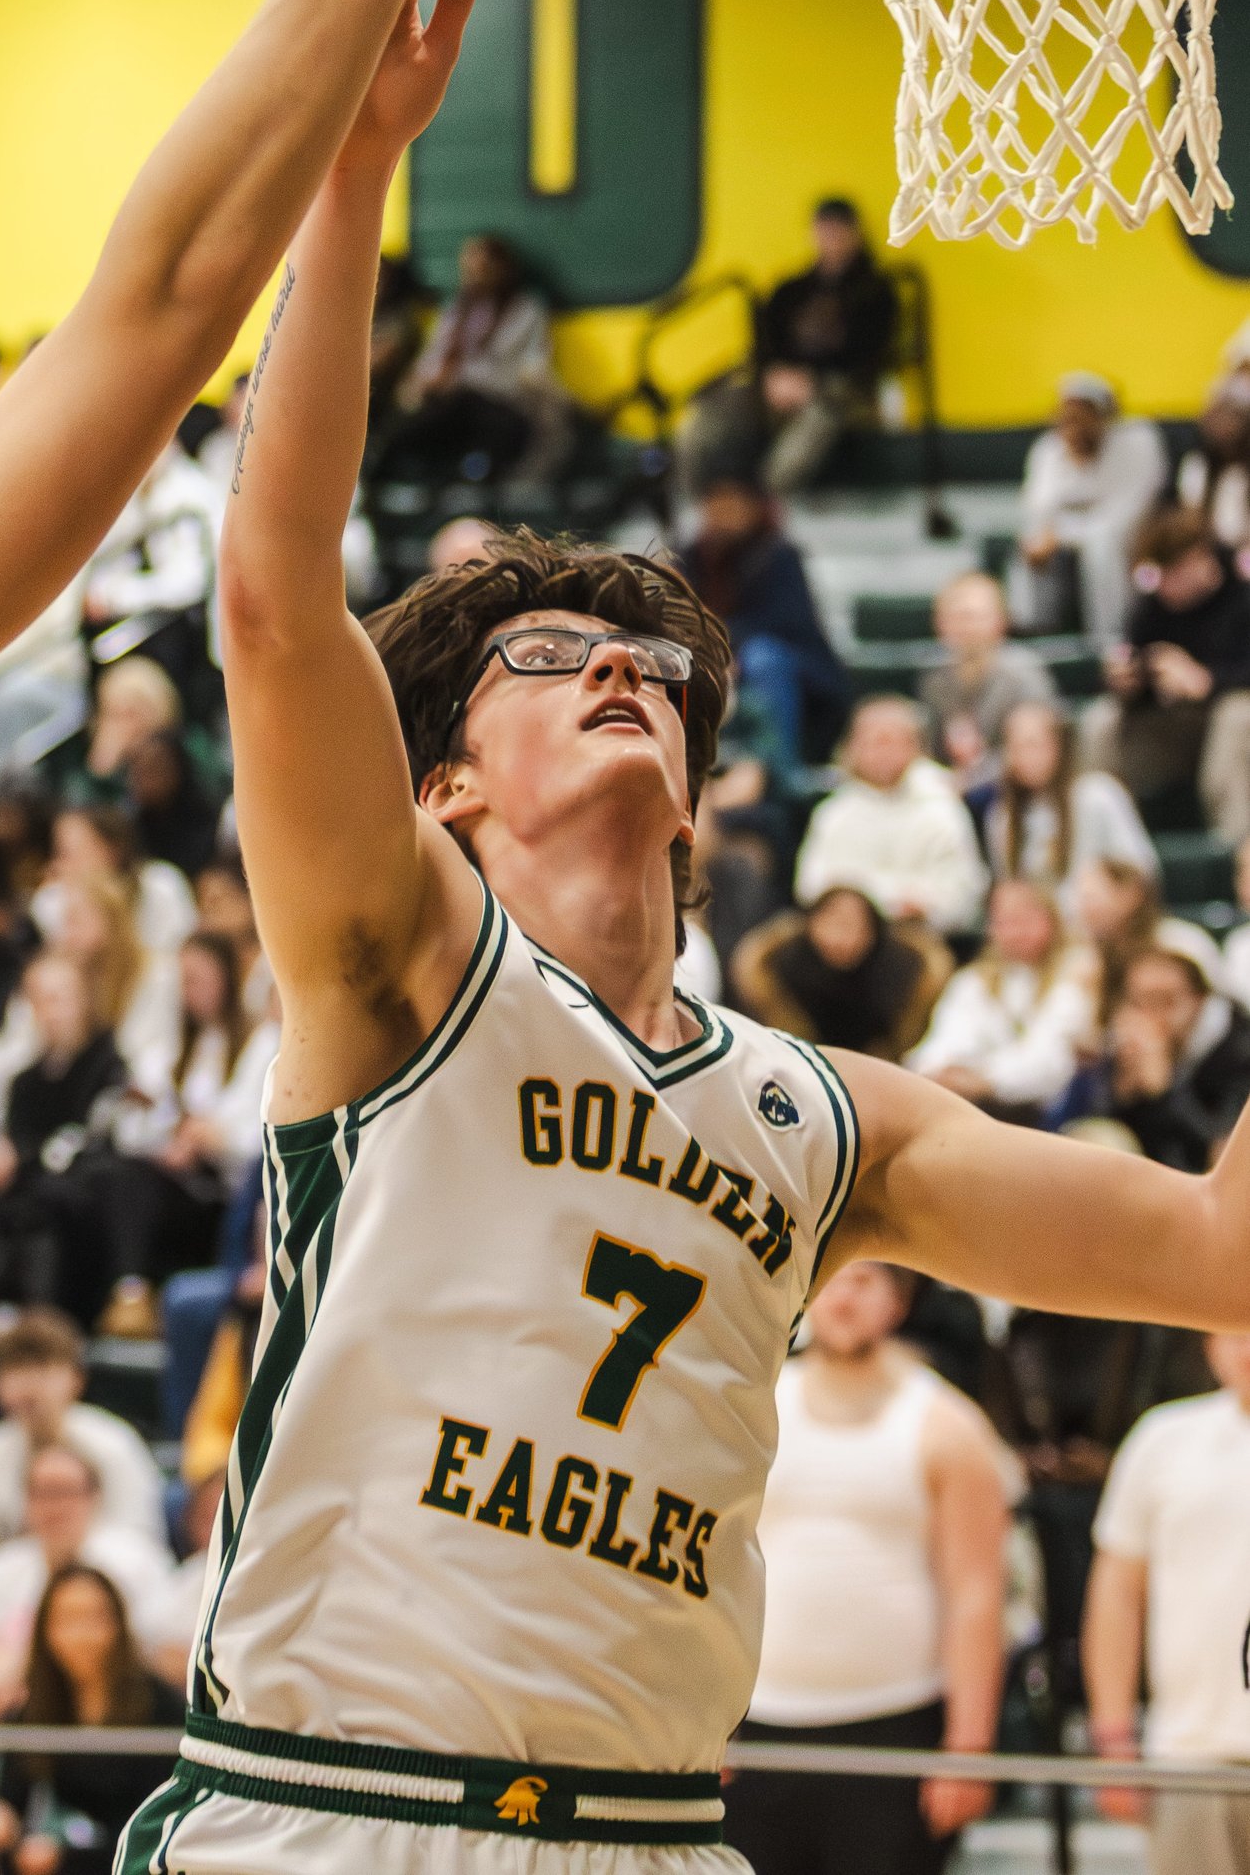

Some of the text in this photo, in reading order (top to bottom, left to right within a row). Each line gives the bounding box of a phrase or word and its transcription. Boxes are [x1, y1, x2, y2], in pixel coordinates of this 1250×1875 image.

[517, 1077, 798, 1278] GOLDEN
[576, 1229, 707, 1433] 7
[418, 1415, 718, 1601] EAGLES
